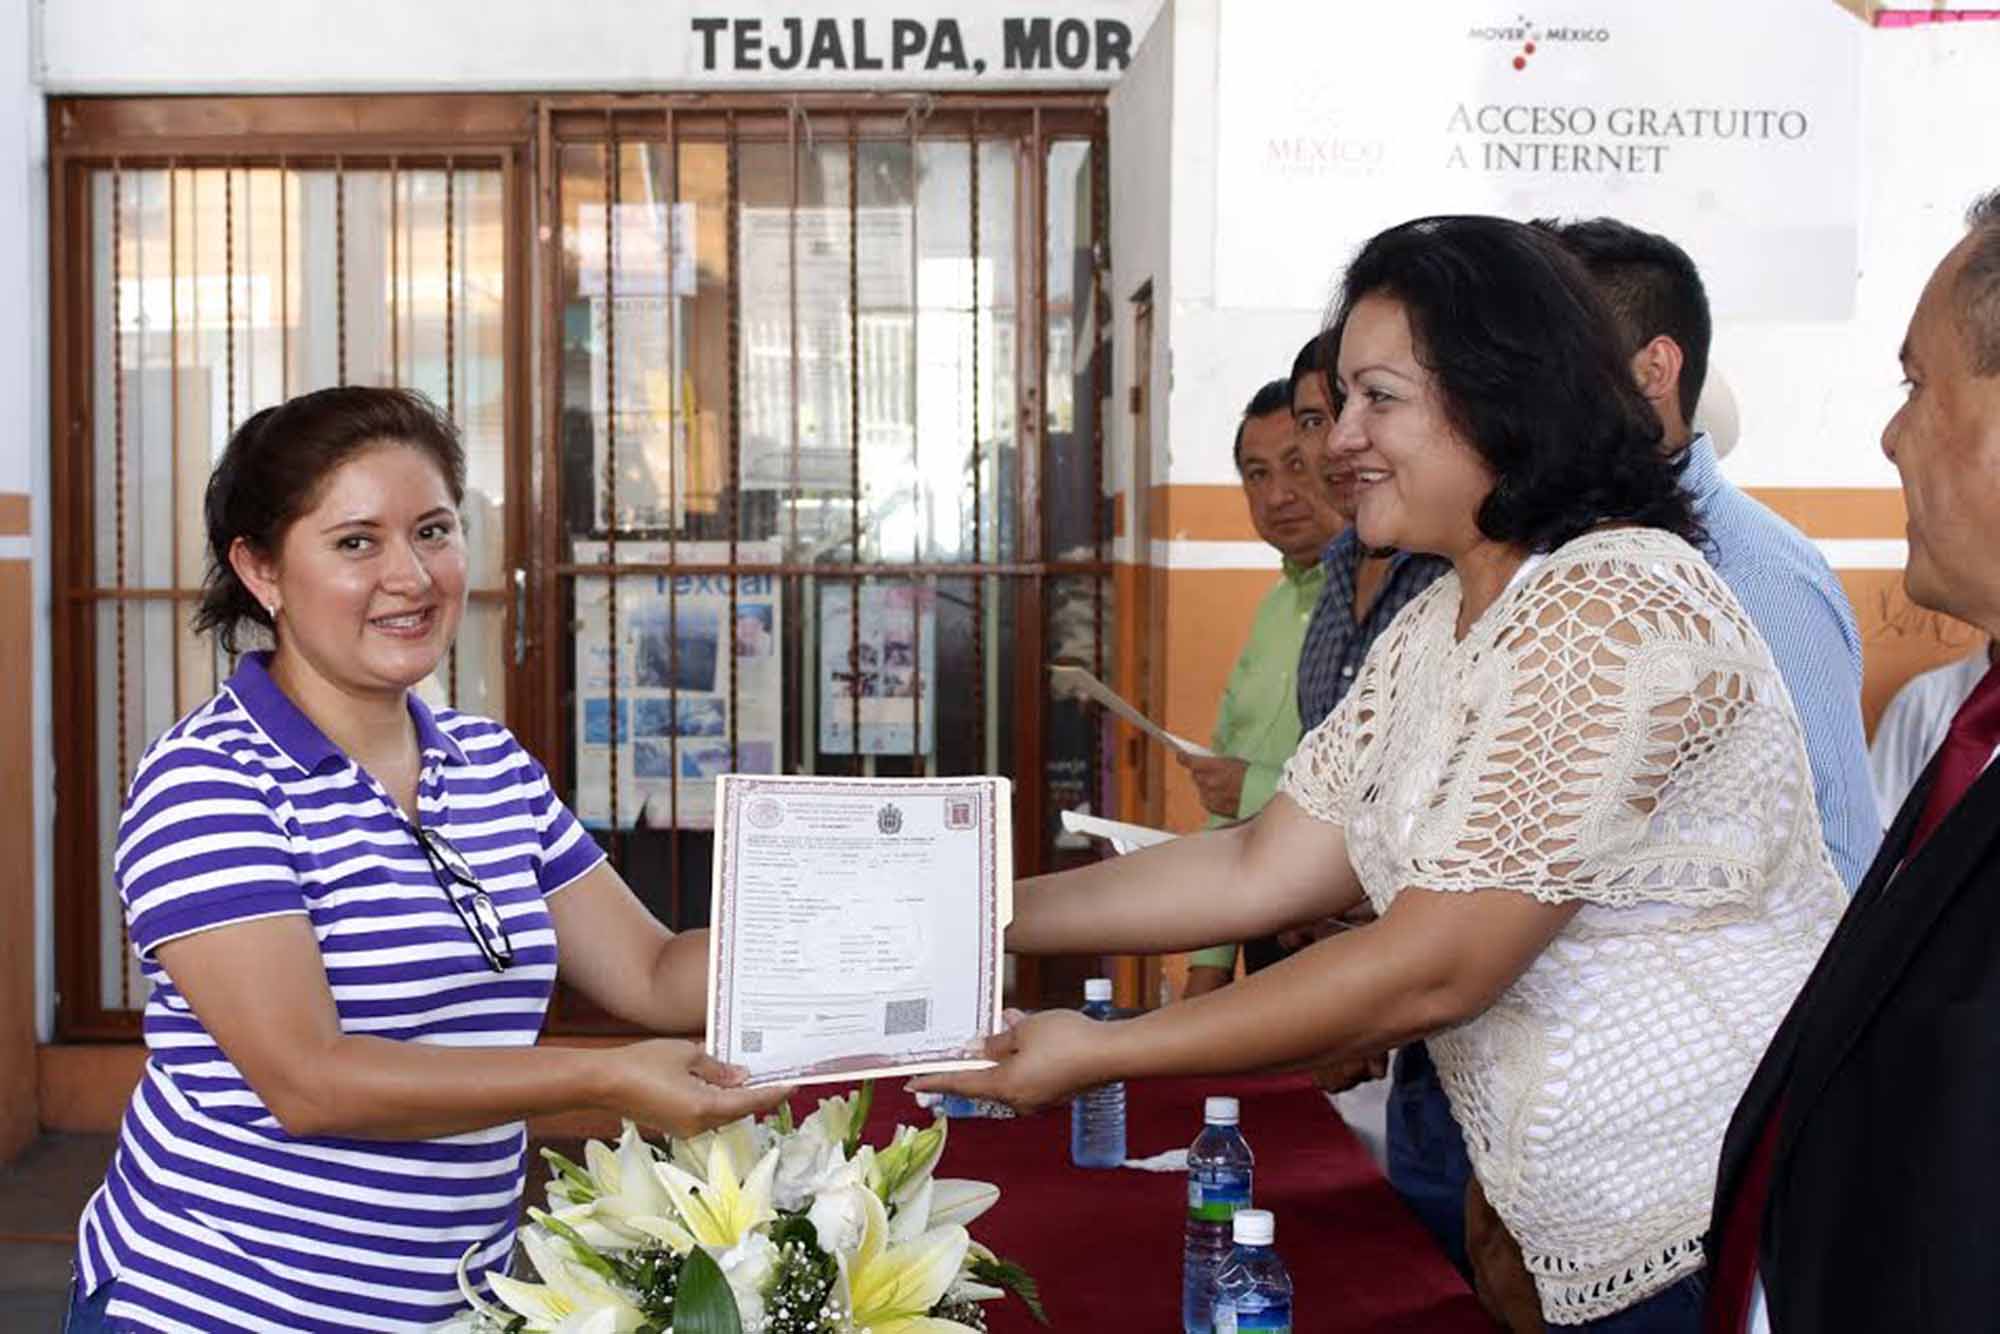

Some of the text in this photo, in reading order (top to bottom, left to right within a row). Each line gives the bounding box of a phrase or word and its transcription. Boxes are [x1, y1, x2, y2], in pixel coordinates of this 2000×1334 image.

[691, 18, 1132, 75] TEJALPA, MOR
[1446, 104, 1808, 140] ACCESO GRATUITO
[1446, 142, 1669, 173] A INTERNET
